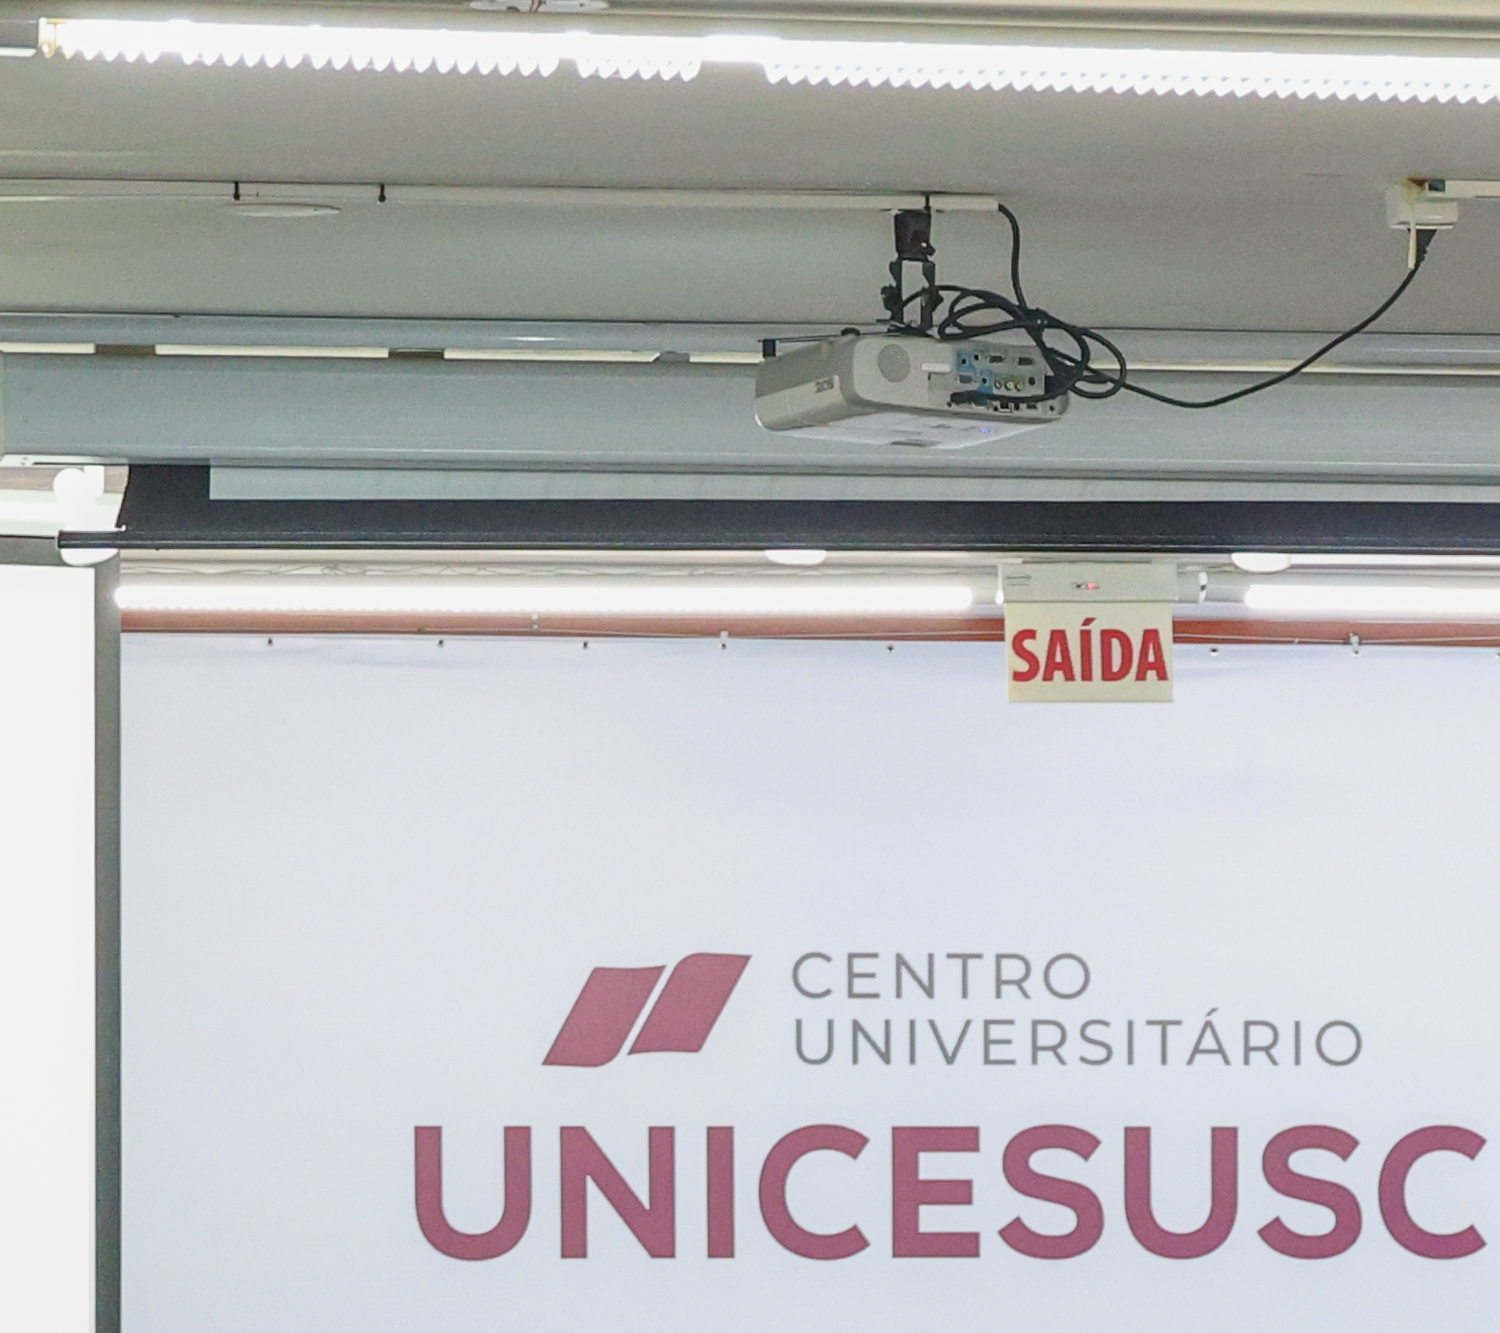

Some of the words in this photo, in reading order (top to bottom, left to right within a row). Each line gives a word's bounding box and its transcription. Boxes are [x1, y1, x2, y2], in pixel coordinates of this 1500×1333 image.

[1011, 616, 1169, 682] SAÍDA
[791, 952, 1092, 1000] CENTRO
[794, 1008, 1363, 1068] UNIVERSITÁRIO
[414, 1123, 1487, 1261] UNICESUSC
